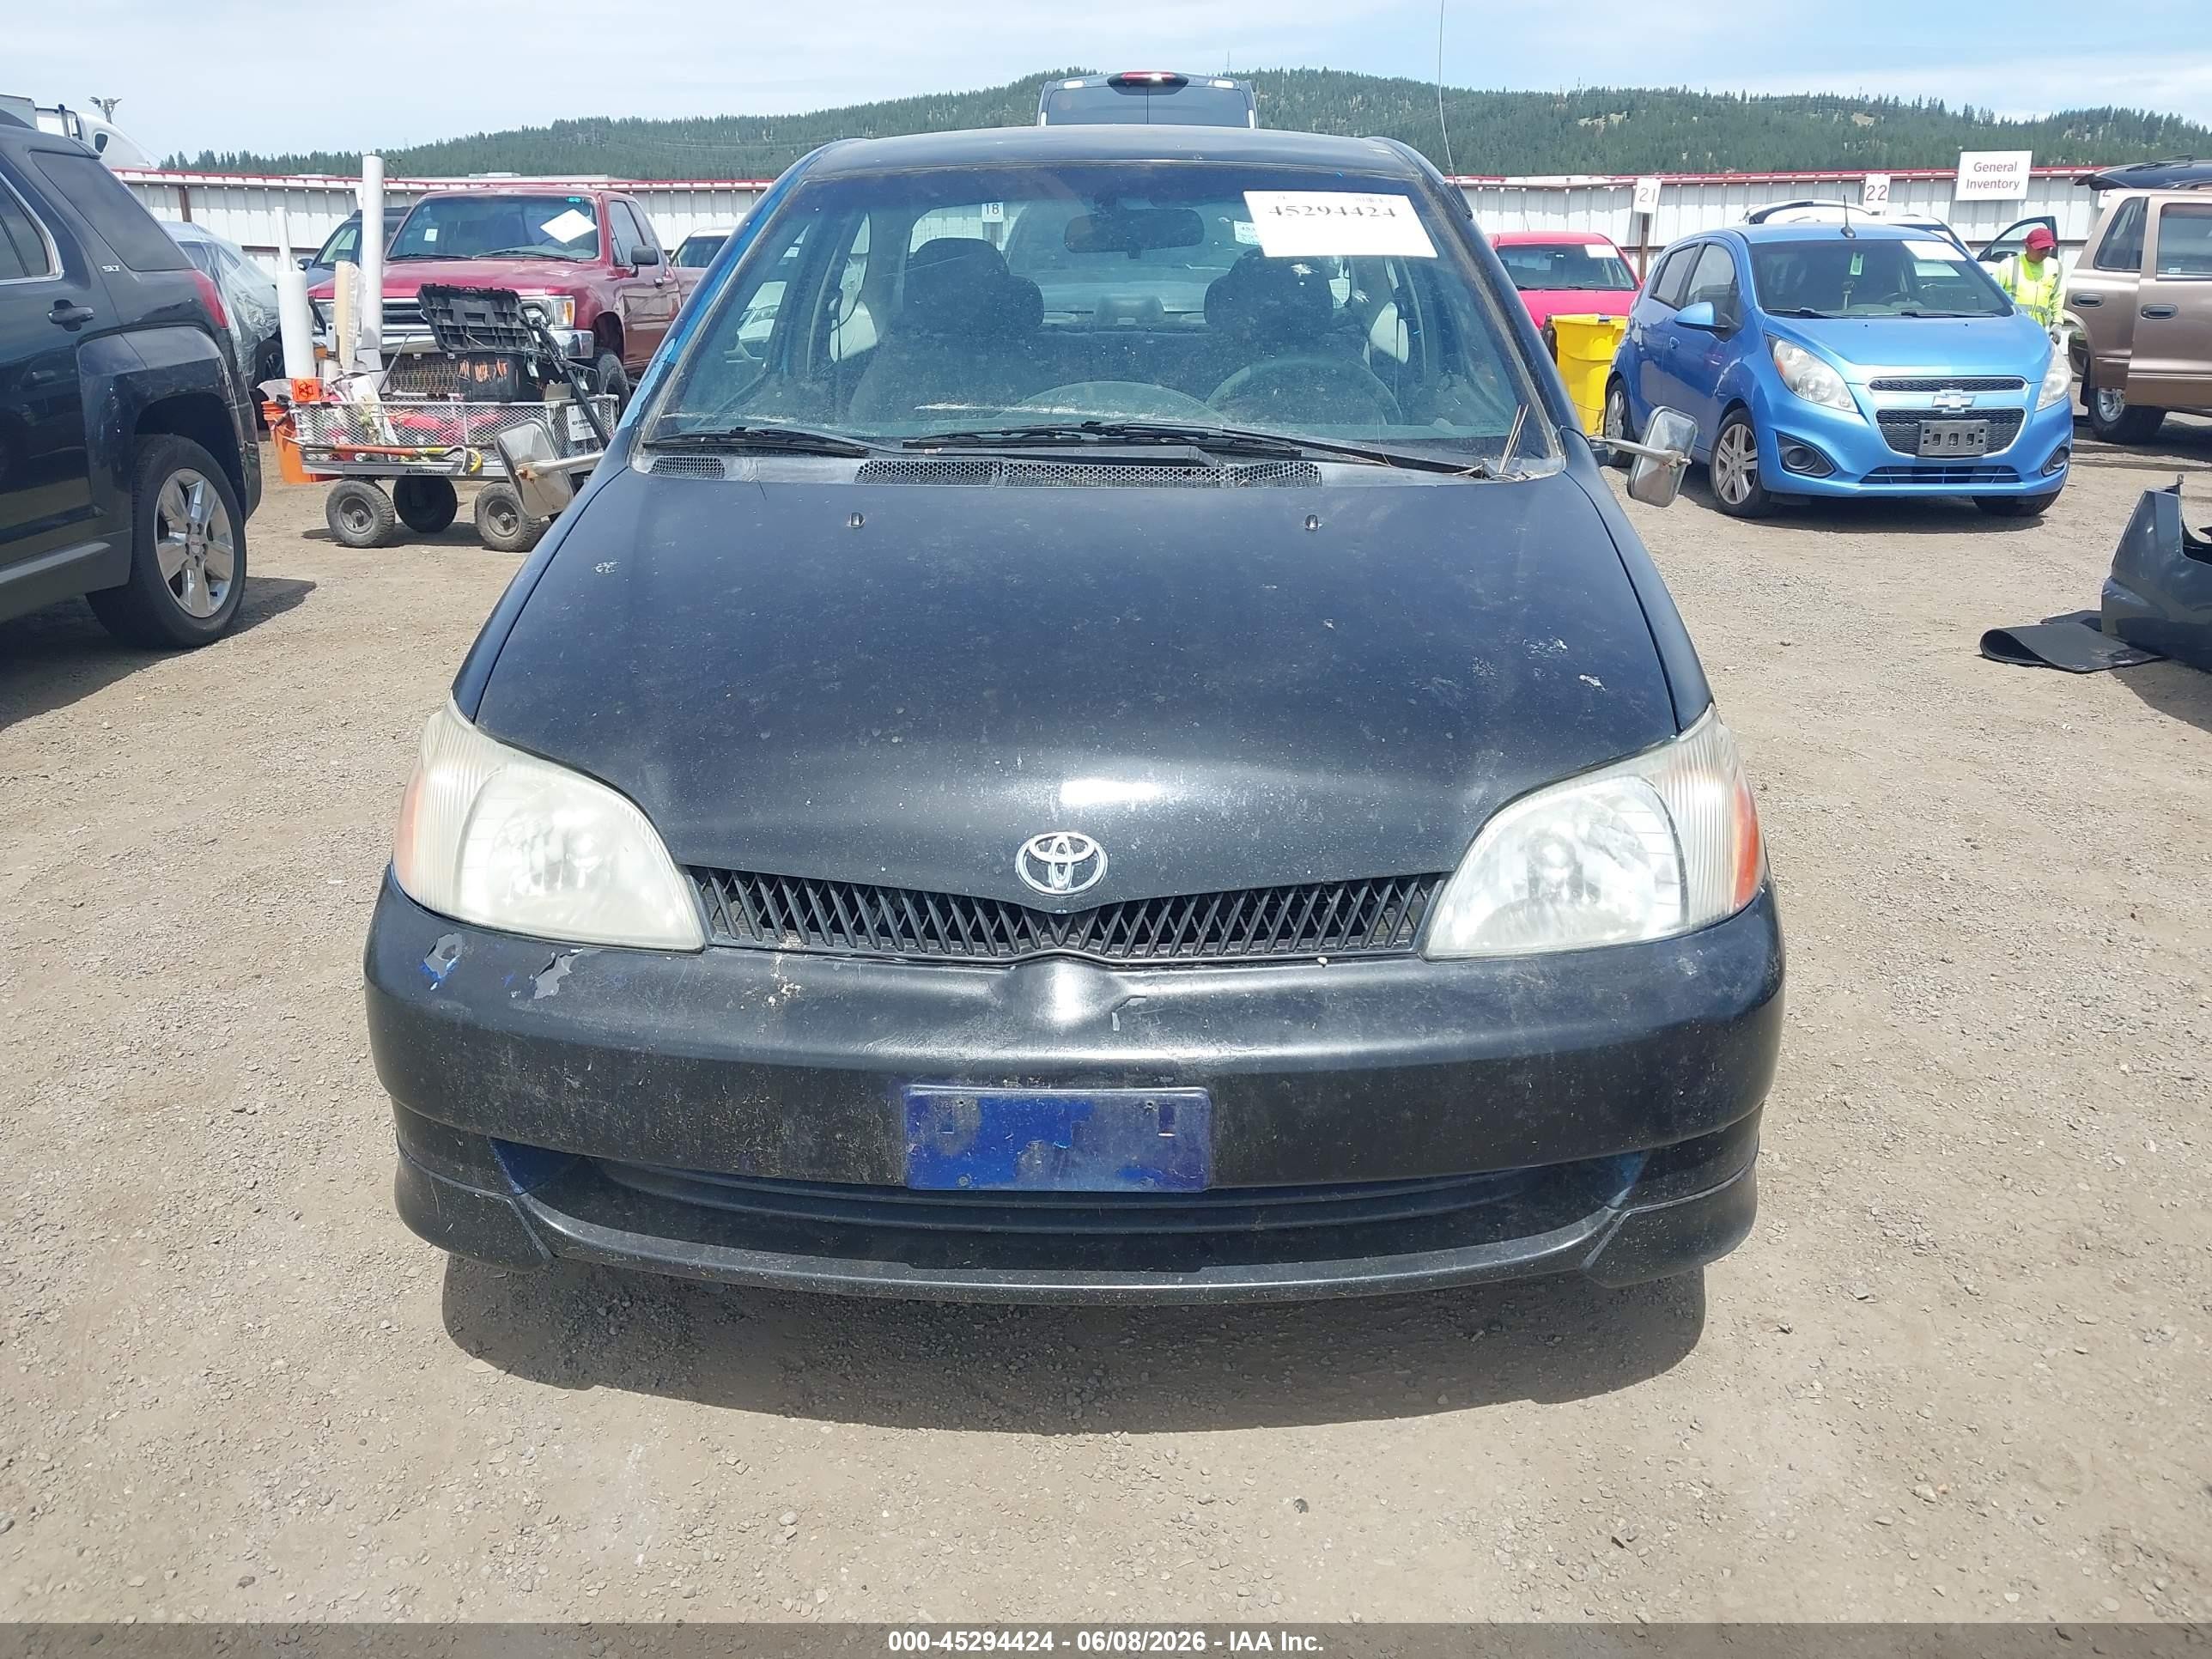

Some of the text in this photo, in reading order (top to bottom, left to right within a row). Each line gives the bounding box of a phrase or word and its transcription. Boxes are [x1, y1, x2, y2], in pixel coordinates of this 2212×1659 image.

[1973, 161, 2018, 173] General
[1966, 179, 2021, 191] Inventory
[1638, 187, 1656, 203] 21
[1865, 185, 1887, 201] 22
[986, 204, 1000, 215] 18
[1268, 205, 1396, 217] 45294424
